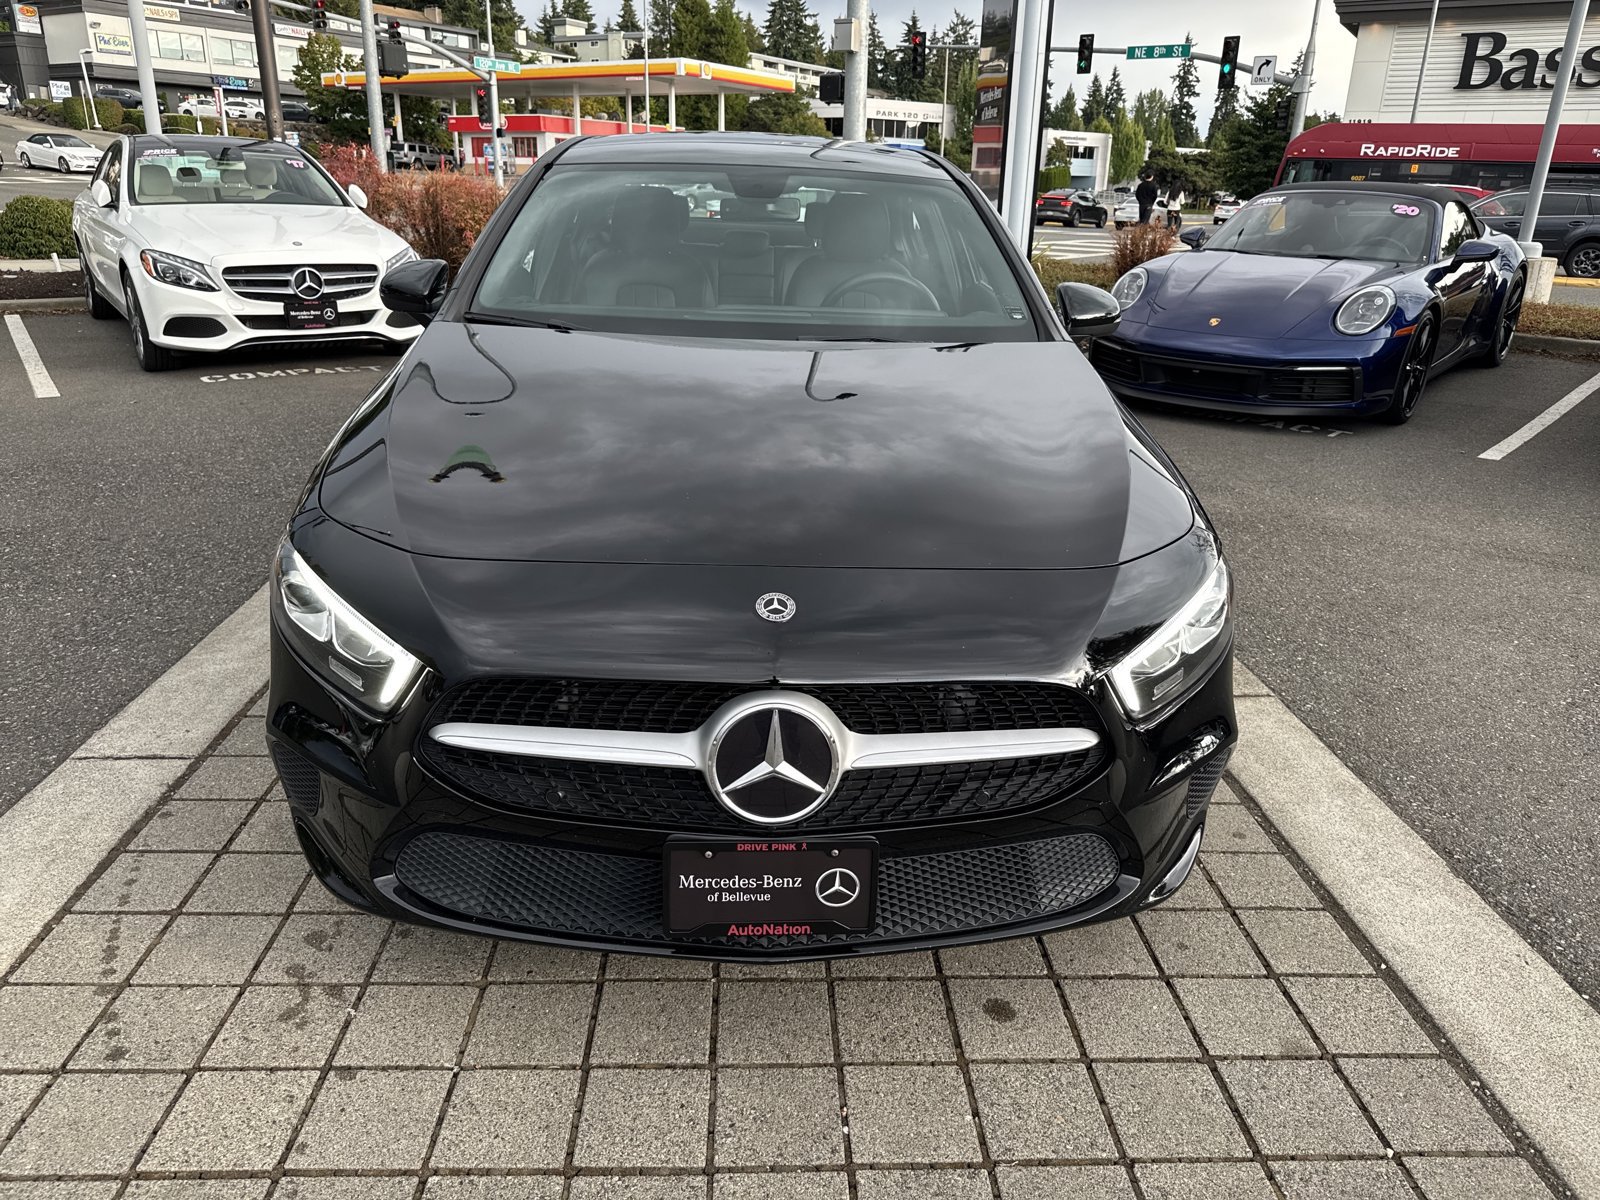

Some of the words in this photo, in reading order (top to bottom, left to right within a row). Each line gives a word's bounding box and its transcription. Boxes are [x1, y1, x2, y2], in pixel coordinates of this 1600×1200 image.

[1134, 48, 1147, 58] NE
[1154, 47, 1166, 58] 8th
[1172, 46, 1182, 56] St
[479, 58, 493, 69] 120th
[496, 61, 506, 70] Ave
[508, 62, 516, 72] NE
[1392, 204, 1420, 216] '20
[200, 366, 382, 383] COMPACT
[679, 875, 802, 888] Mercedes-Benz
[707, 892, 720, 902] of
[722, 892, 771, 902] Bellevue
[728, 924, 811, 936] AutoNation
